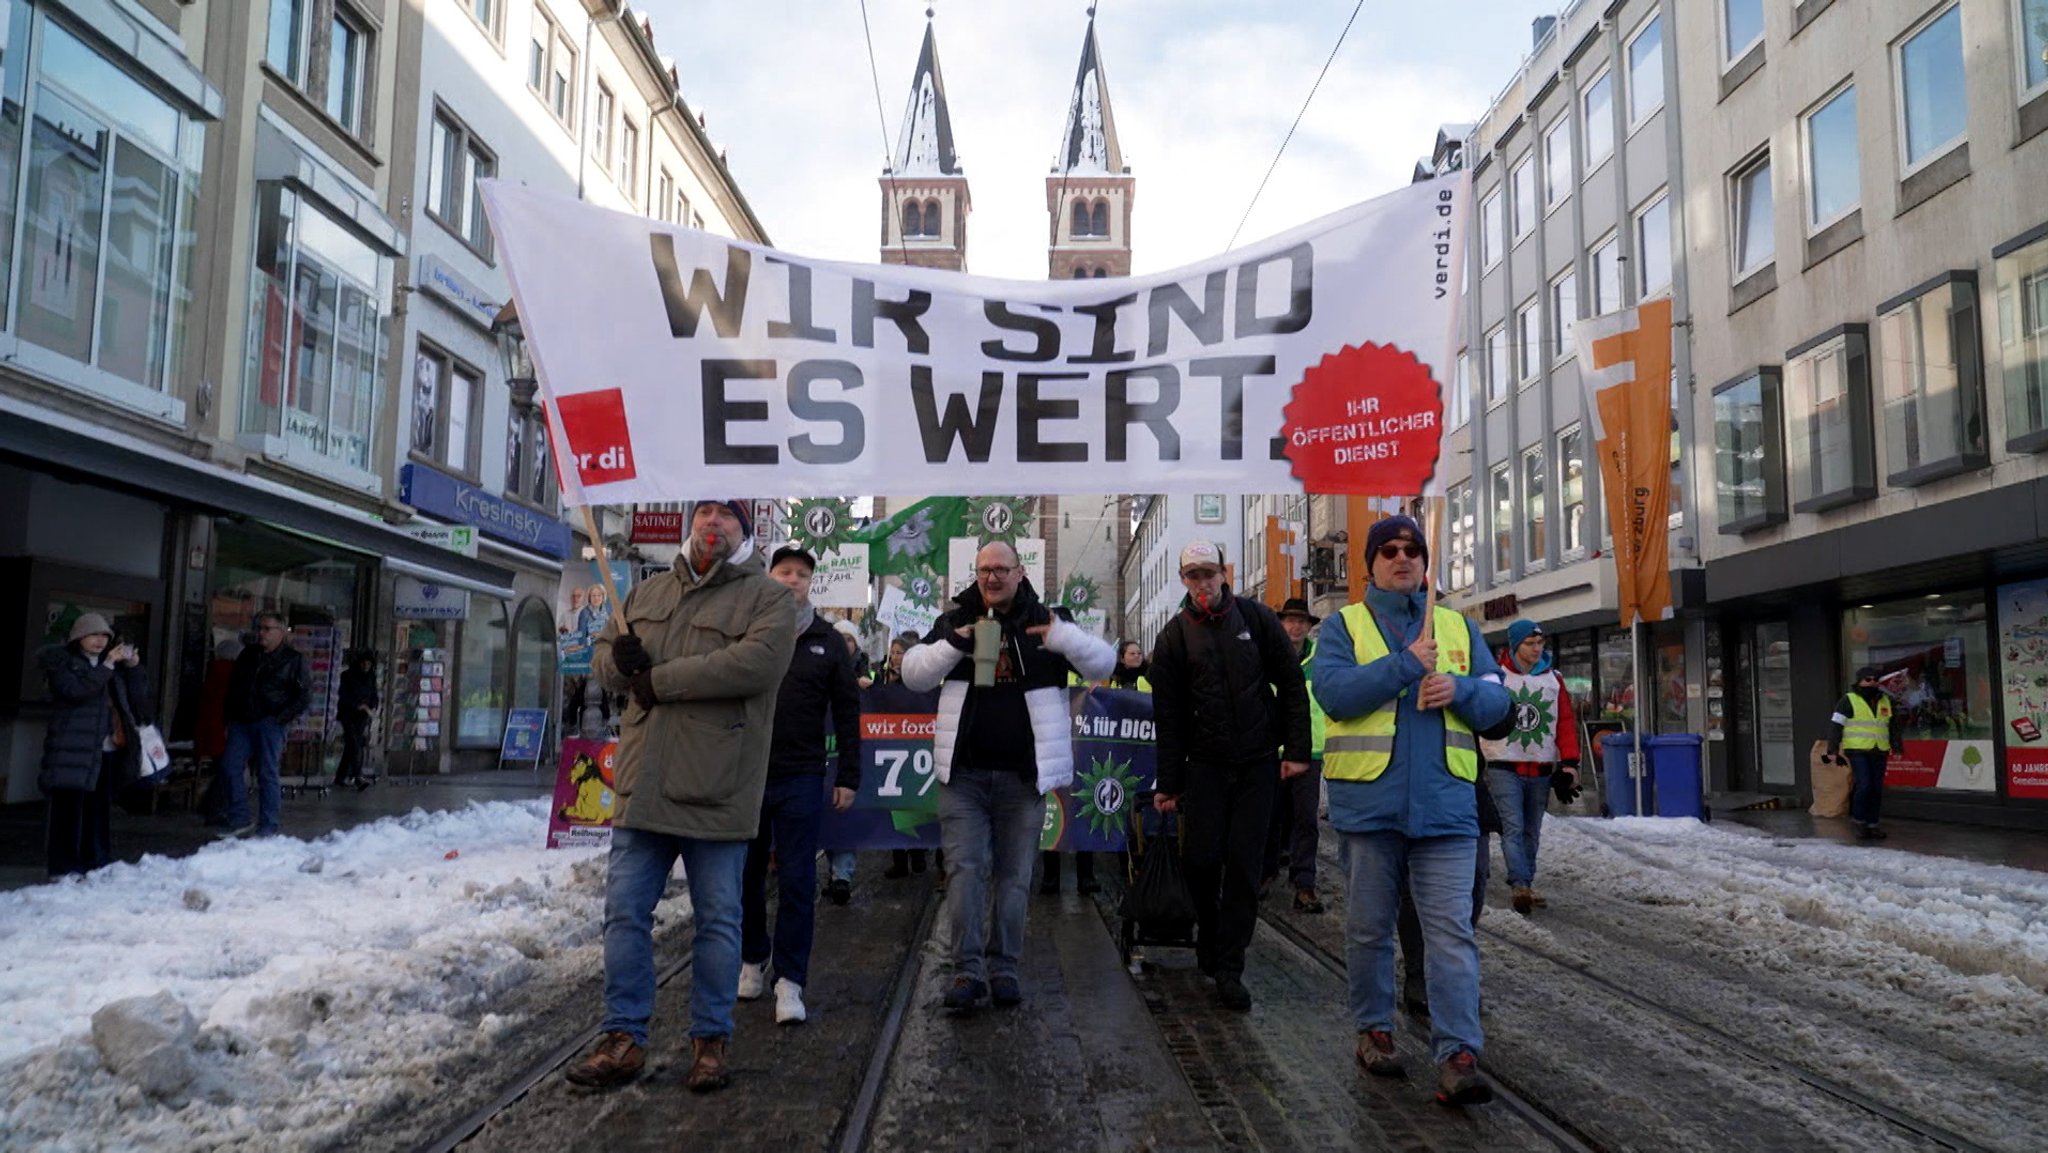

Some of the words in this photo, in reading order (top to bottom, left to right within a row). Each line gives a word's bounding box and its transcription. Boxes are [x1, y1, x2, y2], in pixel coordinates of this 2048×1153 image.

[1434, 189, 1453, 300] verdi.de
[650, 232, 931, 355] WIR
[981, 240, 1314, 364] SIND
[700, 358, 866, 465] ES
[911, 354, 1288, 463] WERT.
[1347, 396, 1380, 418] IHR
[1291, 409, 1436, 448] ÖFFENTLICHER
[1333, 439, 1401, 466] DIENST
[455, 484, 544, 544] Kresinsky
[395, 604, 463, 617] Kresinsky
[866, 718, 897, 735] wir
[1093, 716, 1118, 737] für
